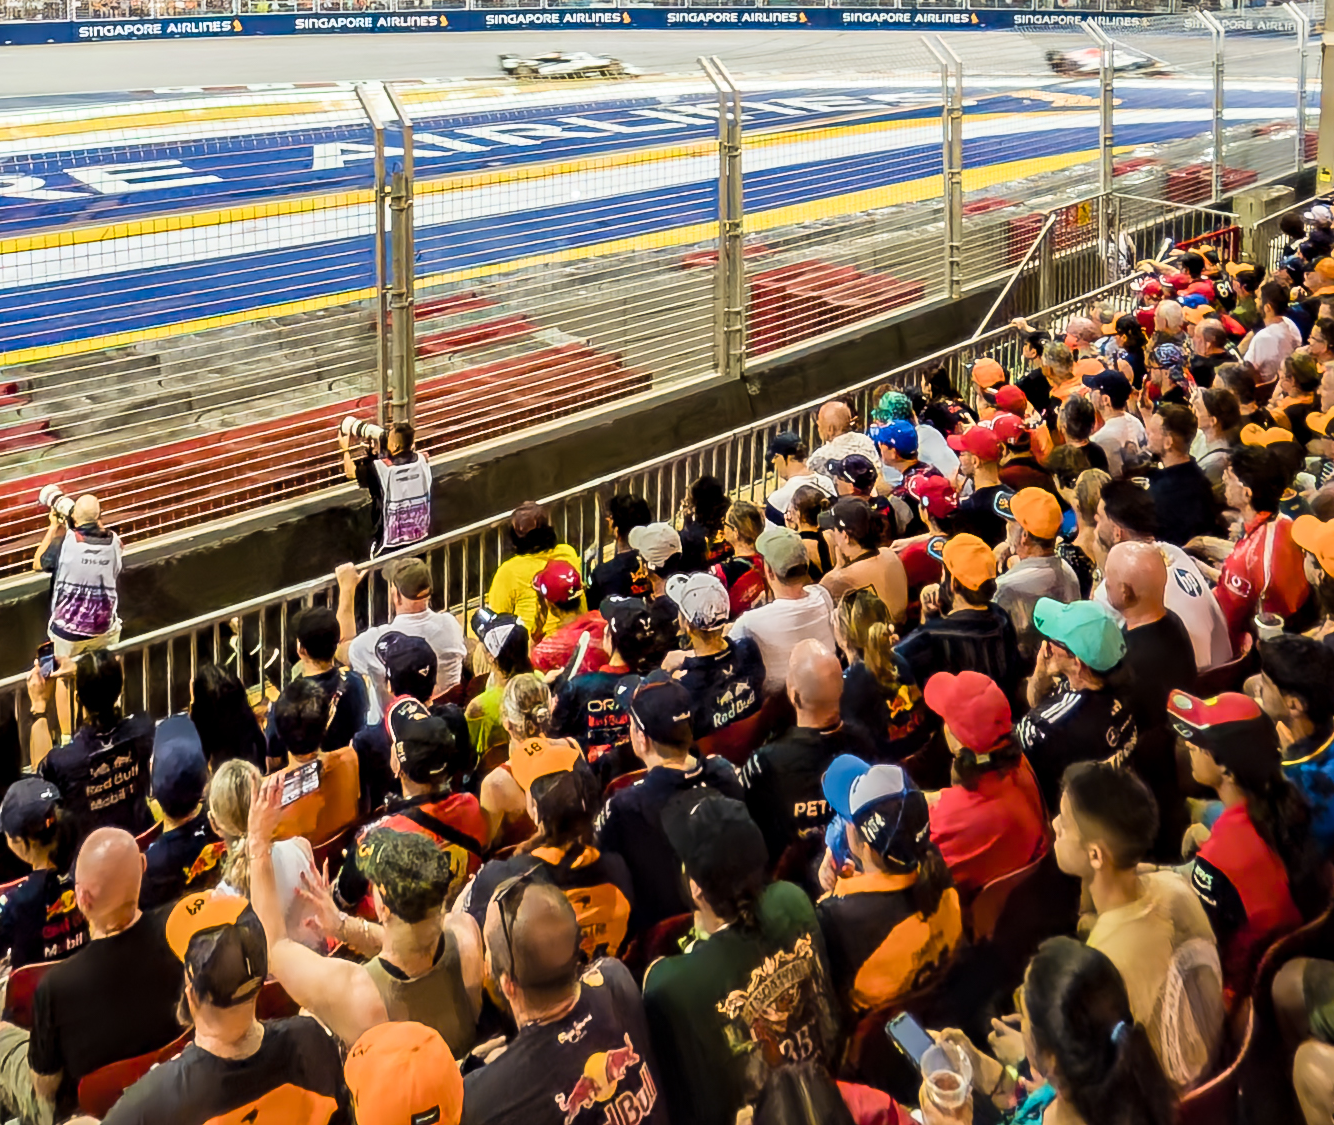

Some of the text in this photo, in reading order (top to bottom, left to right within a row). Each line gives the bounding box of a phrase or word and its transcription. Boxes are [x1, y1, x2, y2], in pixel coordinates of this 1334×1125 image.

[295, 15, 438, 30] SINGAPORE AIRLINES
[485, 13, 620, 26] SINGAPORE AIRLINES
[667, 12, 797, 24] SINGAPORE AIRLINES
[842, 12, 969, 24] SINGAPORE AIRLINES
[1014, 15, 1081, 25] SINGAPORE
[79, 20, 231, 38] SINGAPORE AIRLINES
[86, 763, 139, 796] Red Bull
